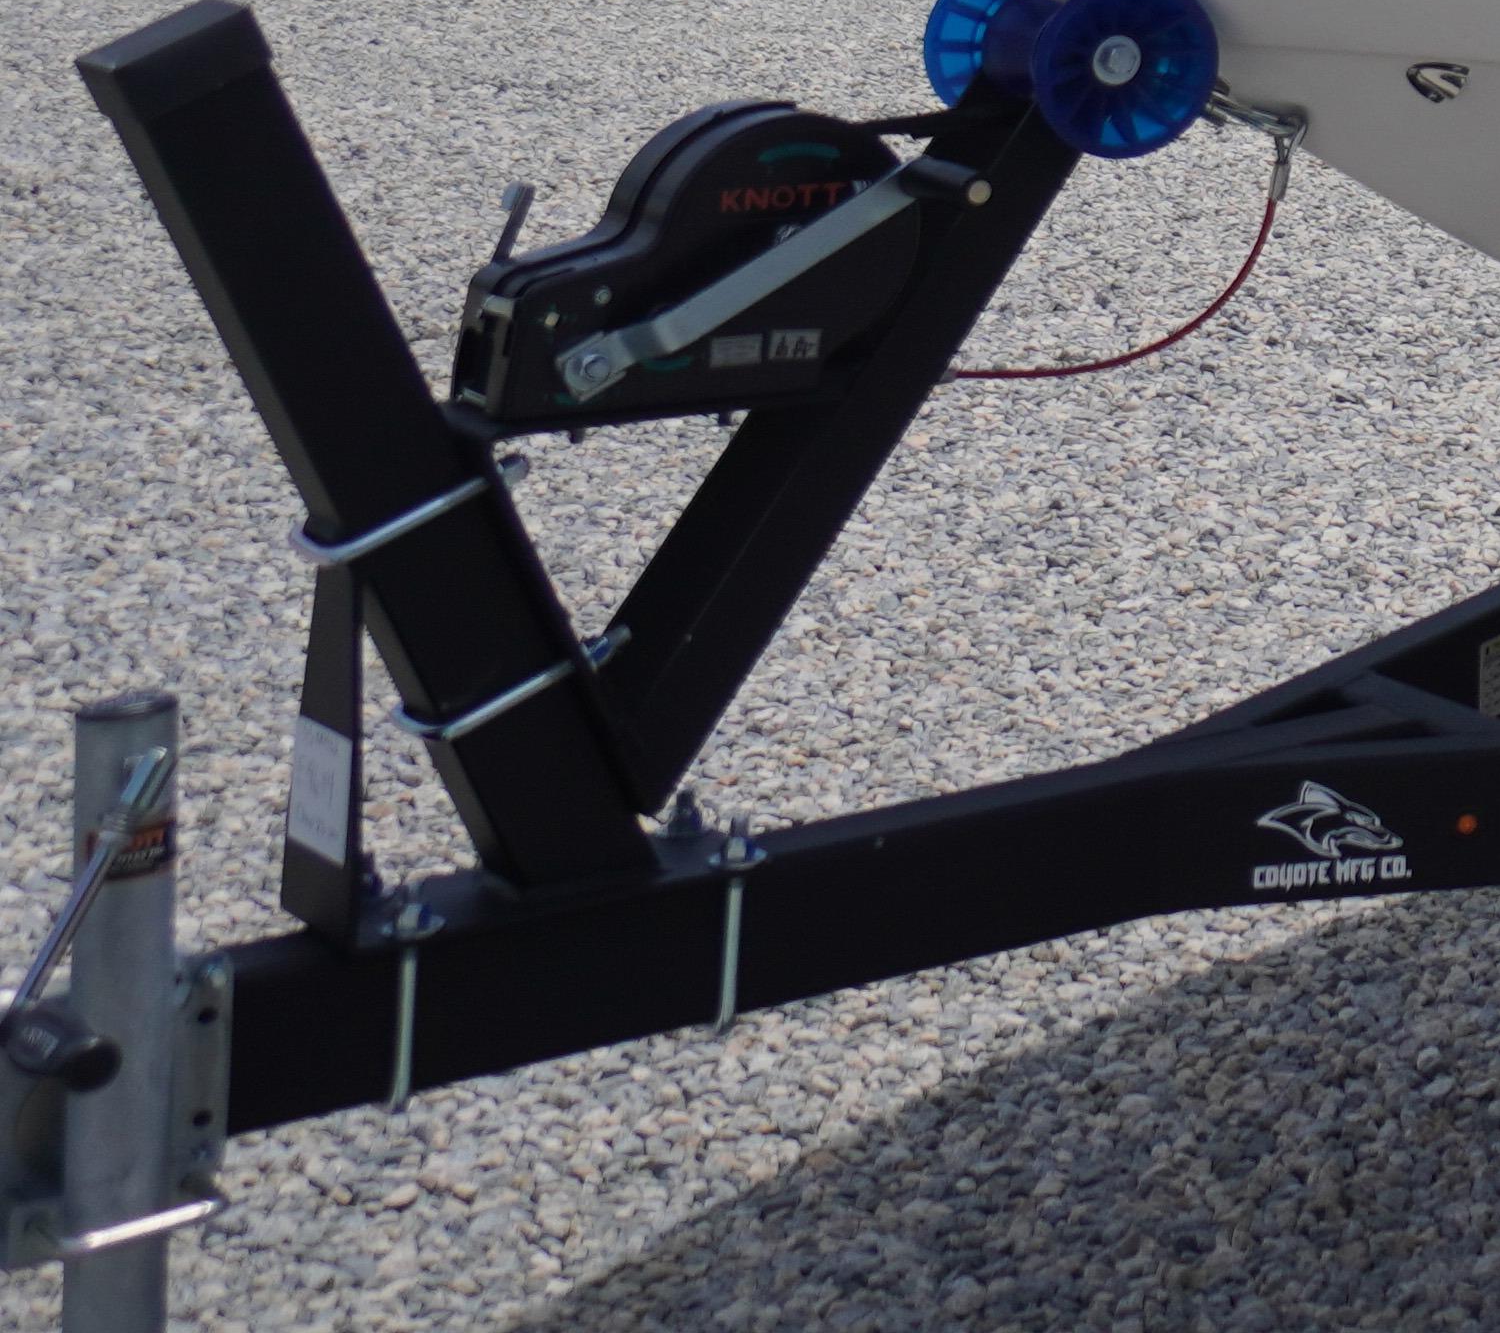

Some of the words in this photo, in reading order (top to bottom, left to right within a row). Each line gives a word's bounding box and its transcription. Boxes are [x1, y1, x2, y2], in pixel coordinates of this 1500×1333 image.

[719, 181, 847, 213] KNOTT
[1253, 861, 1331, 893] COYOTE
[1335, 856, 1378, 885] MFG
[1380, 854, 1413, 880] CO.
